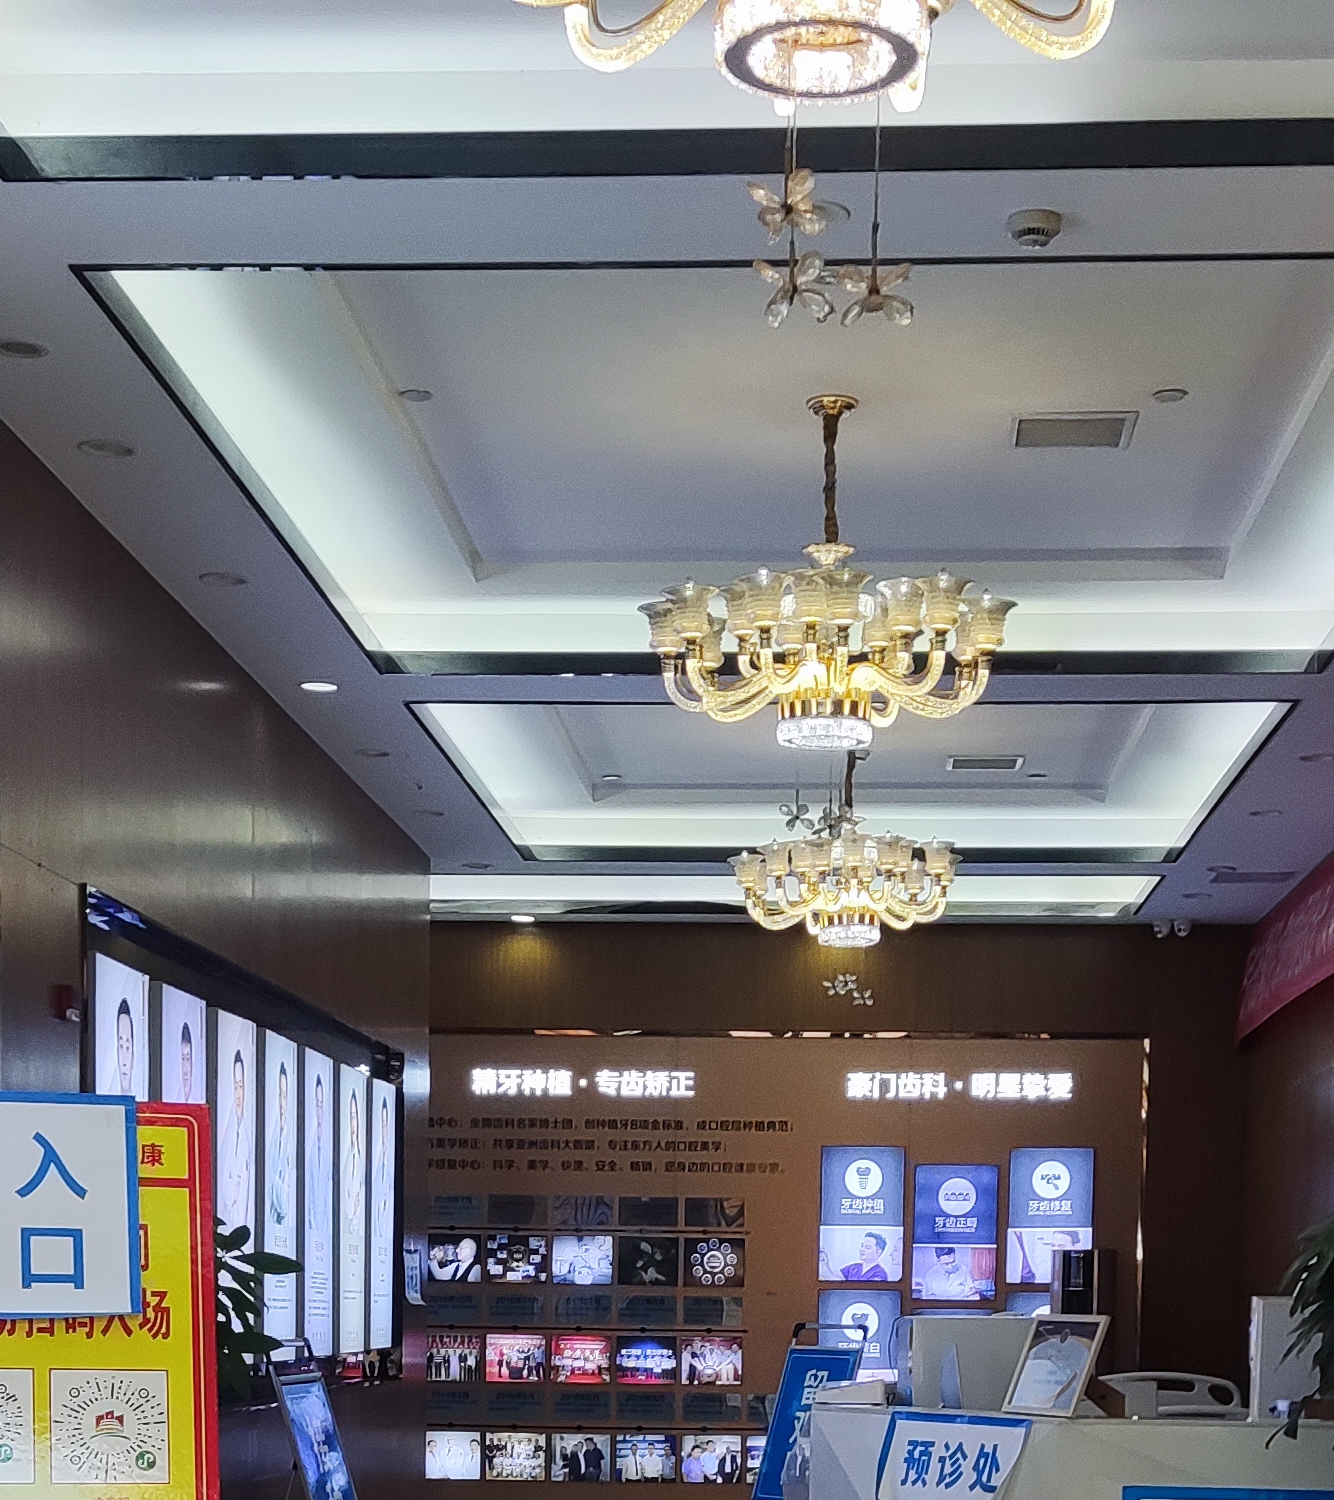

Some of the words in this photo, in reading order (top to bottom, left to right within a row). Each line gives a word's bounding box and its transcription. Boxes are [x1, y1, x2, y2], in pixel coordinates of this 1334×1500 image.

[14, 1131, 89, 1289] 入口
[900, 1439, 1001, 1495] 预诊处
